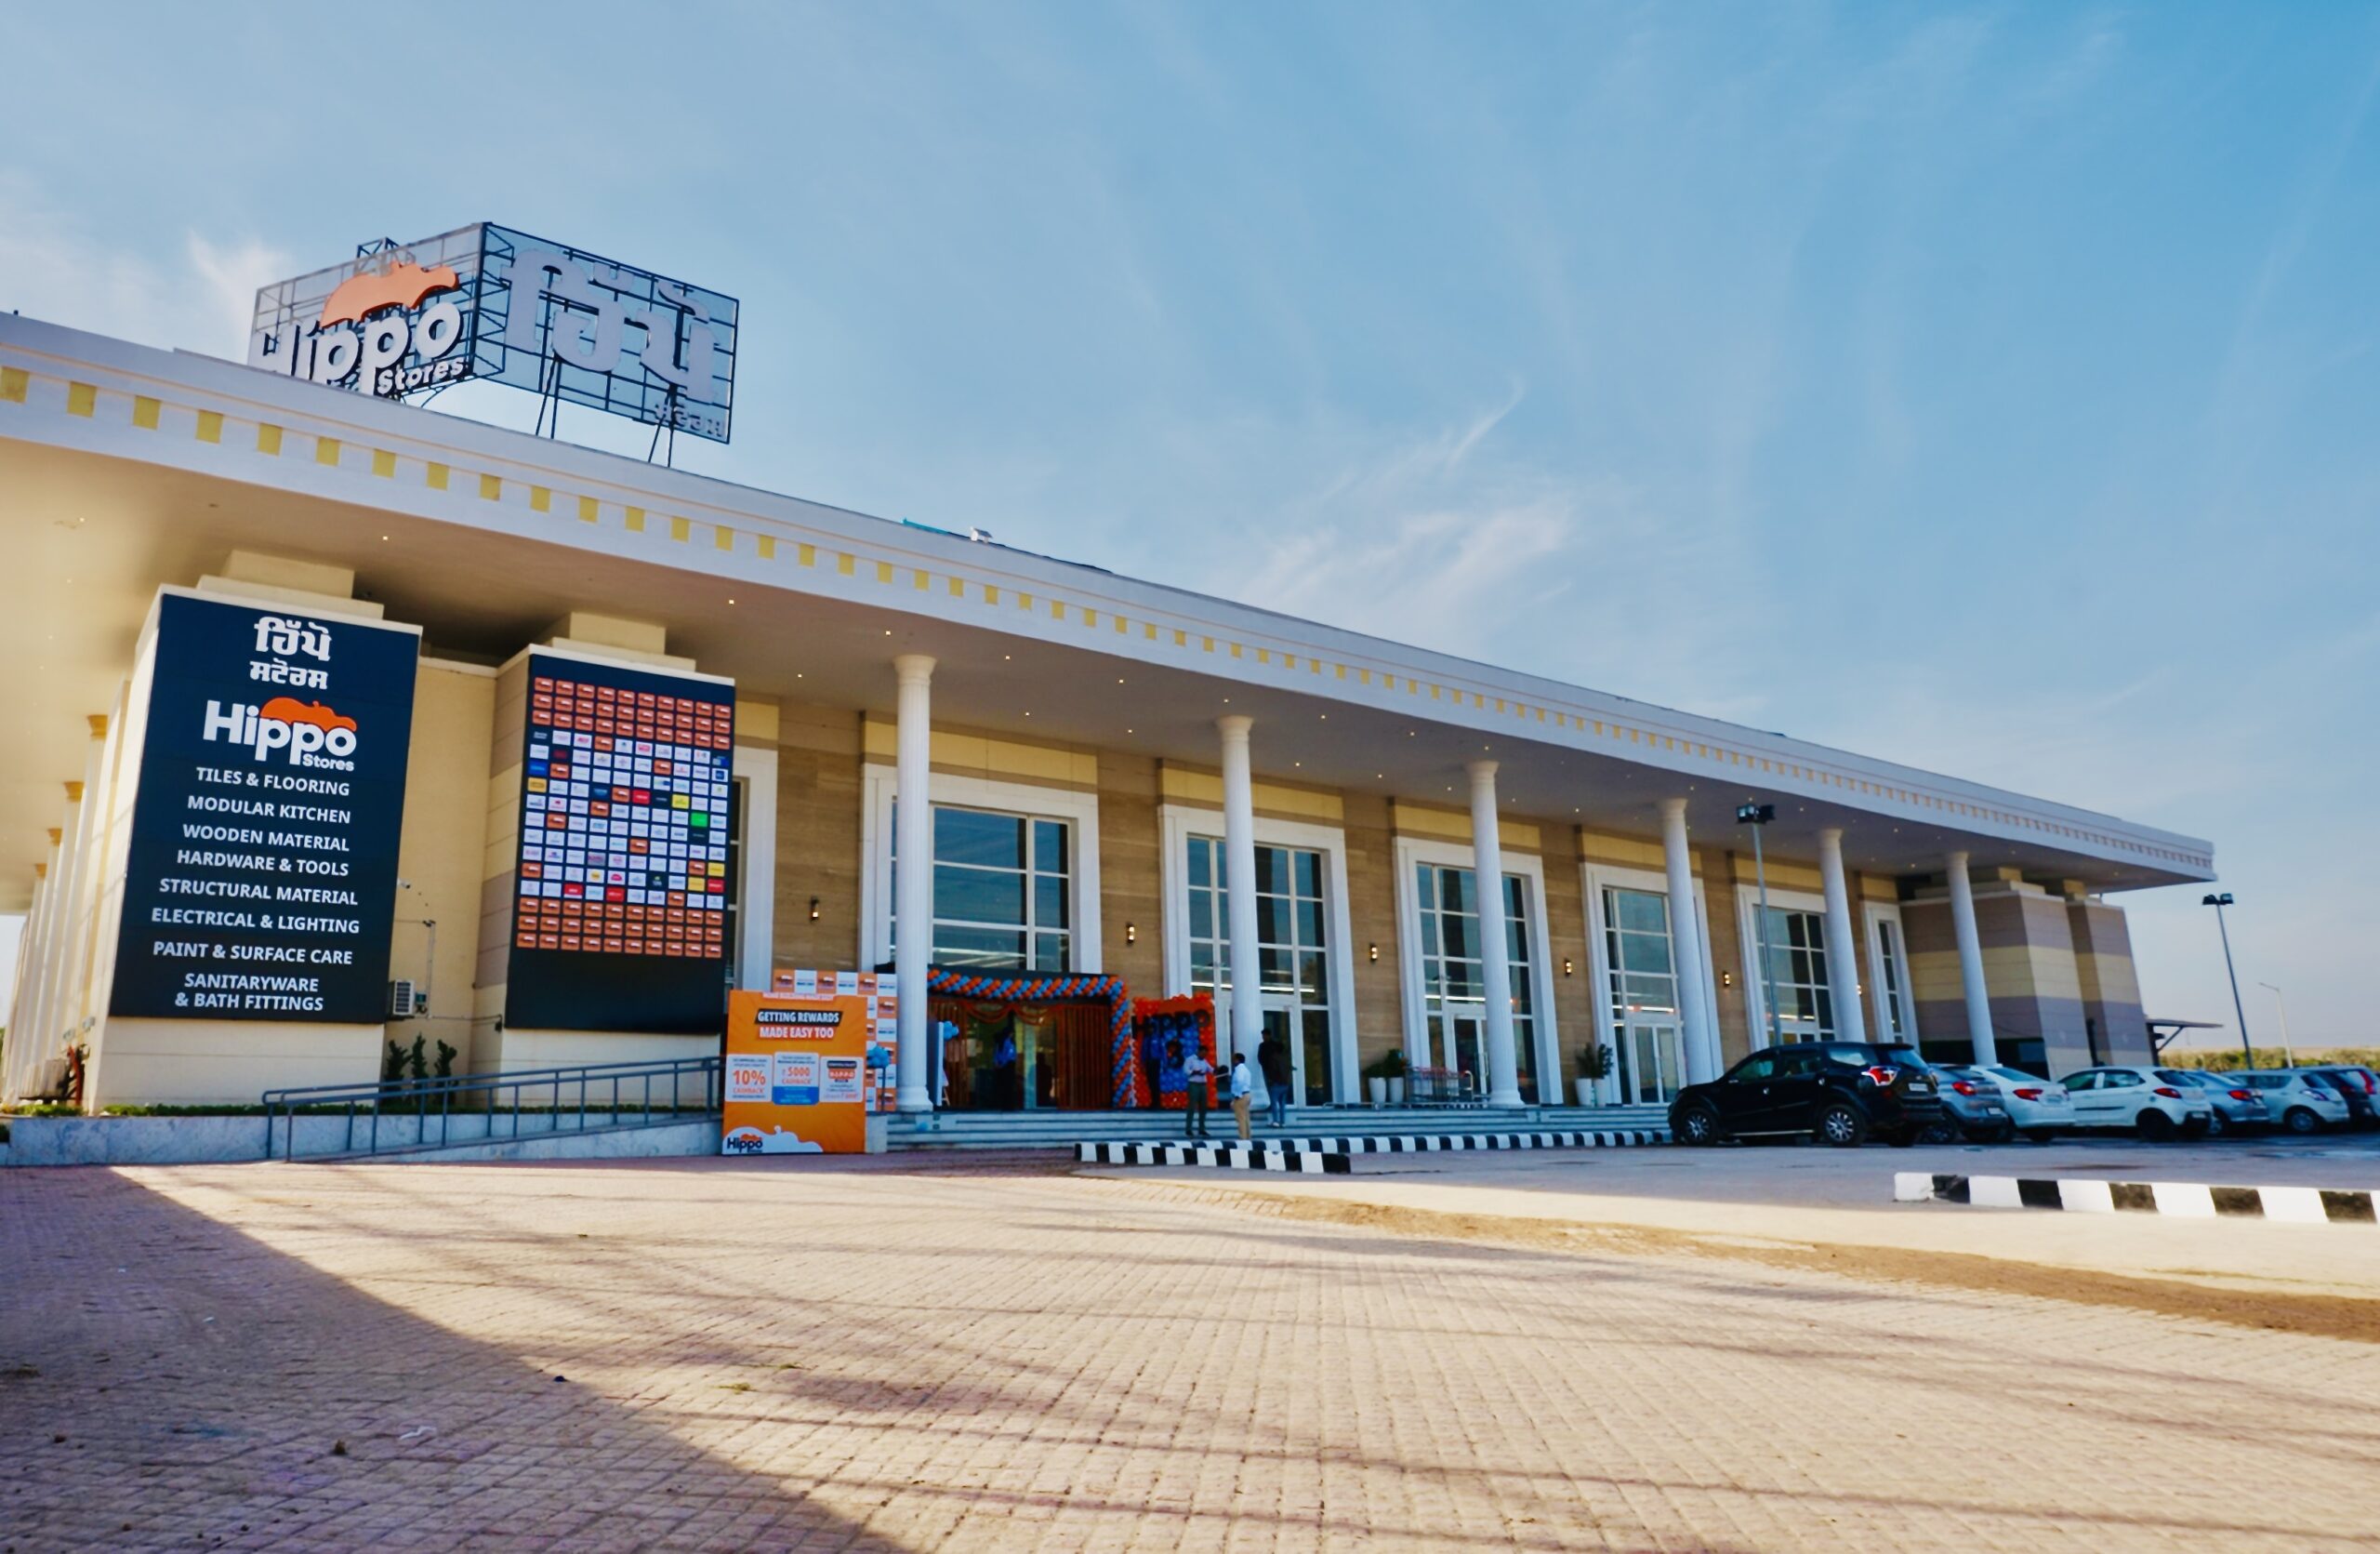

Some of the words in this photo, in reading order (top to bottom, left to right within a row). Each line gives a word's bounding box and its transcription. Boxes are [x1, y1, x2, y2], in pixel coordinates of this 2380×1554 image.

[248, 300, 463, 395] Hippo
[203, 699, 357, 765] Hippo
[302, 753, 355, 772] Stores
[196, 767, 242, 784] TILES
[246, 773, 258, 786] &
[264, 775, 350, 796] FLOORING
[188, 795, 274, 817] MODULAR
[280, 804, 350, 823] KITCHEN
[183, 824, 263, 843] WOODEN
[269, 832, 350, 851] MATERIAL
[178, 850, 275, 870] HARDWARE
[279, 858, 291, 871] &
[297, 859, 349, 876] TOOLS
[160, 879, 271, 899] STRUCTURAL
[276, 886, 358, 905] MATERIAL
[152, 908, 255, 927] ELECTRICAL
[260, 915, 272, 928] &
[278, 916, 359, 933] LIGHTING
[153, 941, 208, 957] PAINT
[213, 945, 226, 958] &
[231, 946, 306, 962] SURFACE
[311, 950, 352, 964] CARE
[185, 974, 319, 991] SANITARYWARE
[175, 992, 188, 1006] &
[194, 993, 239, 1008] BATH
[245, 995, 323, 1011] FITTINGS
[758, 1011, 796, 1022] GETTING
[798, 1012, 840, 1023] REWARDS
[760, 1026, 787, 1038] MADE
[789, 1027, 813, 1038] EASY
[814, 1027, 834, 1039] TOO
[732, 1069, 766, 1085] 10%
[727, 1136, 763, 1153] Hippo
